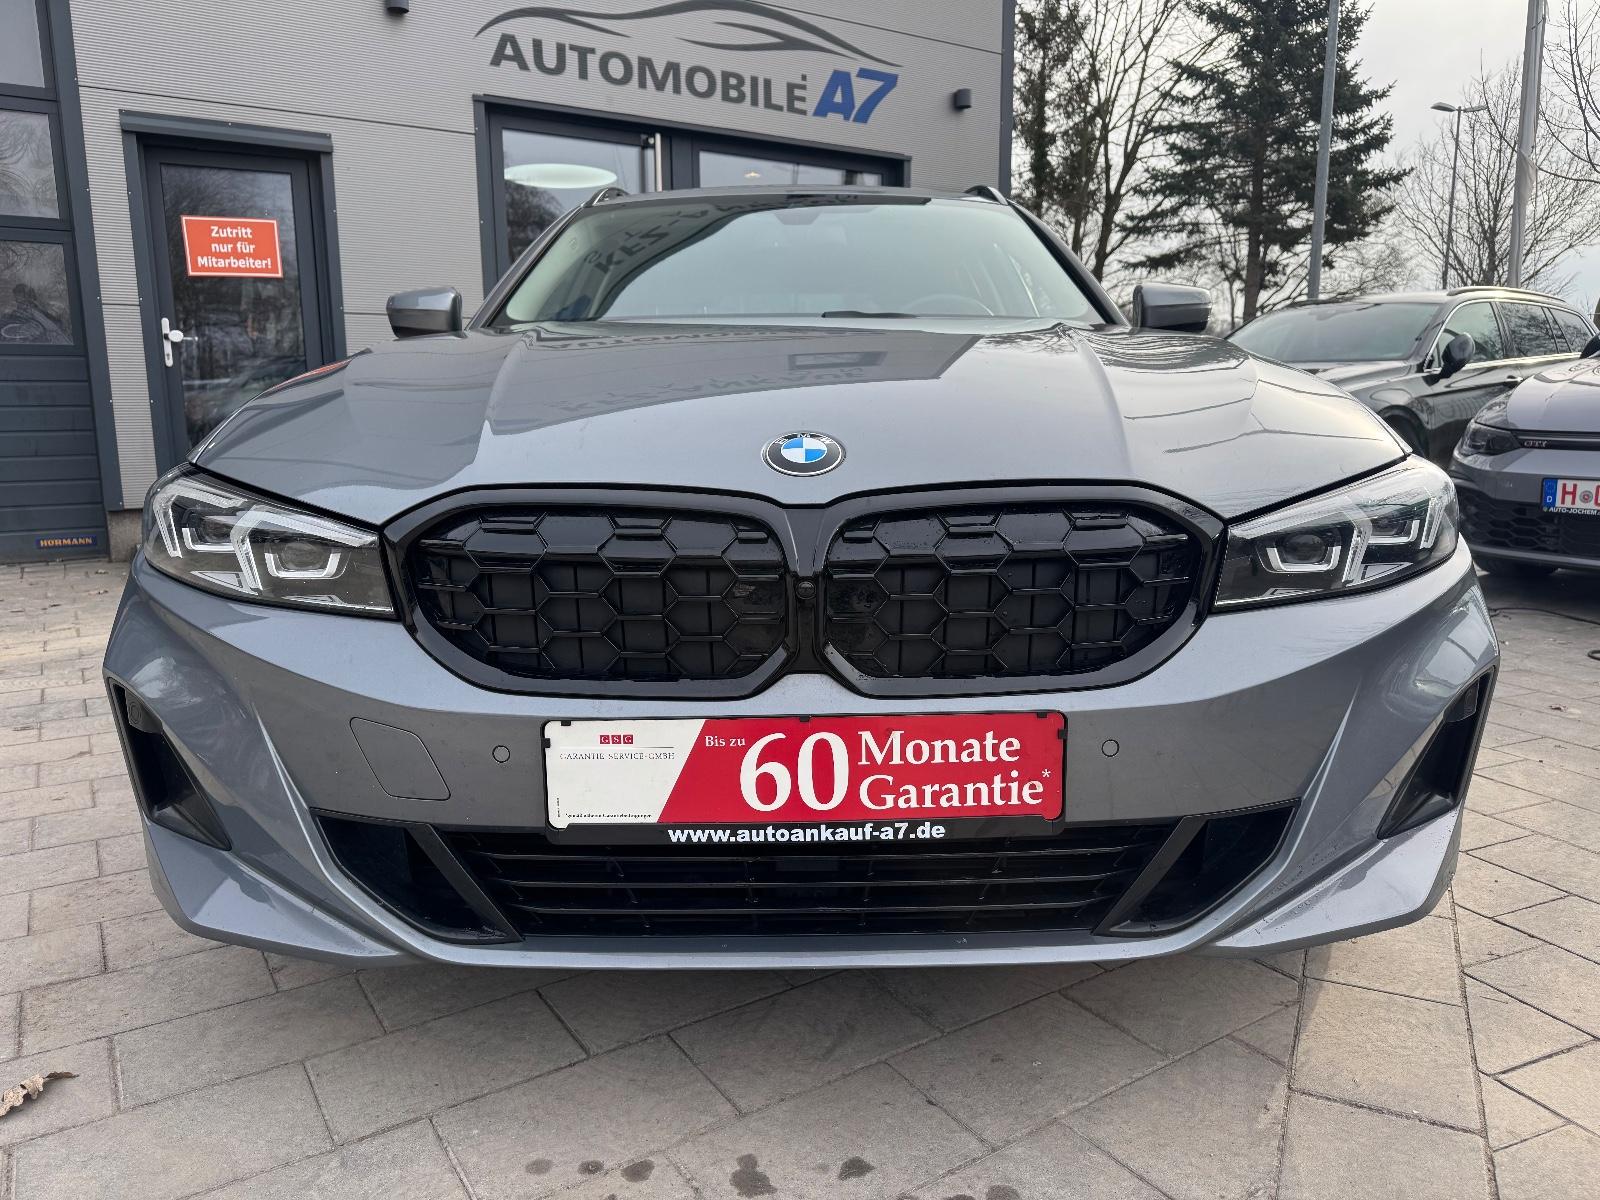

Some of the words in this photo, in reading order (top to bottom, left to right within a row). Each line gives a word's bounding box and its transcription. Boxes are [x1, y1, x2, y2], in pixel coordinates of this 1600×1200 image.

[812, 67, 899, 124] A7
[210, 226, 252, 238] Zutritt
[211, 243, 233, 253] nur
[236, 241, 256, 254] für
[197, 256, 272, 268] Mitarbeiter!
[1547, 495, 1553, 503] D
[1561, 483, 1577, 505] H
[705, 736, 726, 747] Bis
[729, 738, 746, 747] zu
[740, 732, 849, 812] 60
[857, 730, 1021, 766] Monate
[667, 822, 946, 843] www.autoankauf-a7.de
